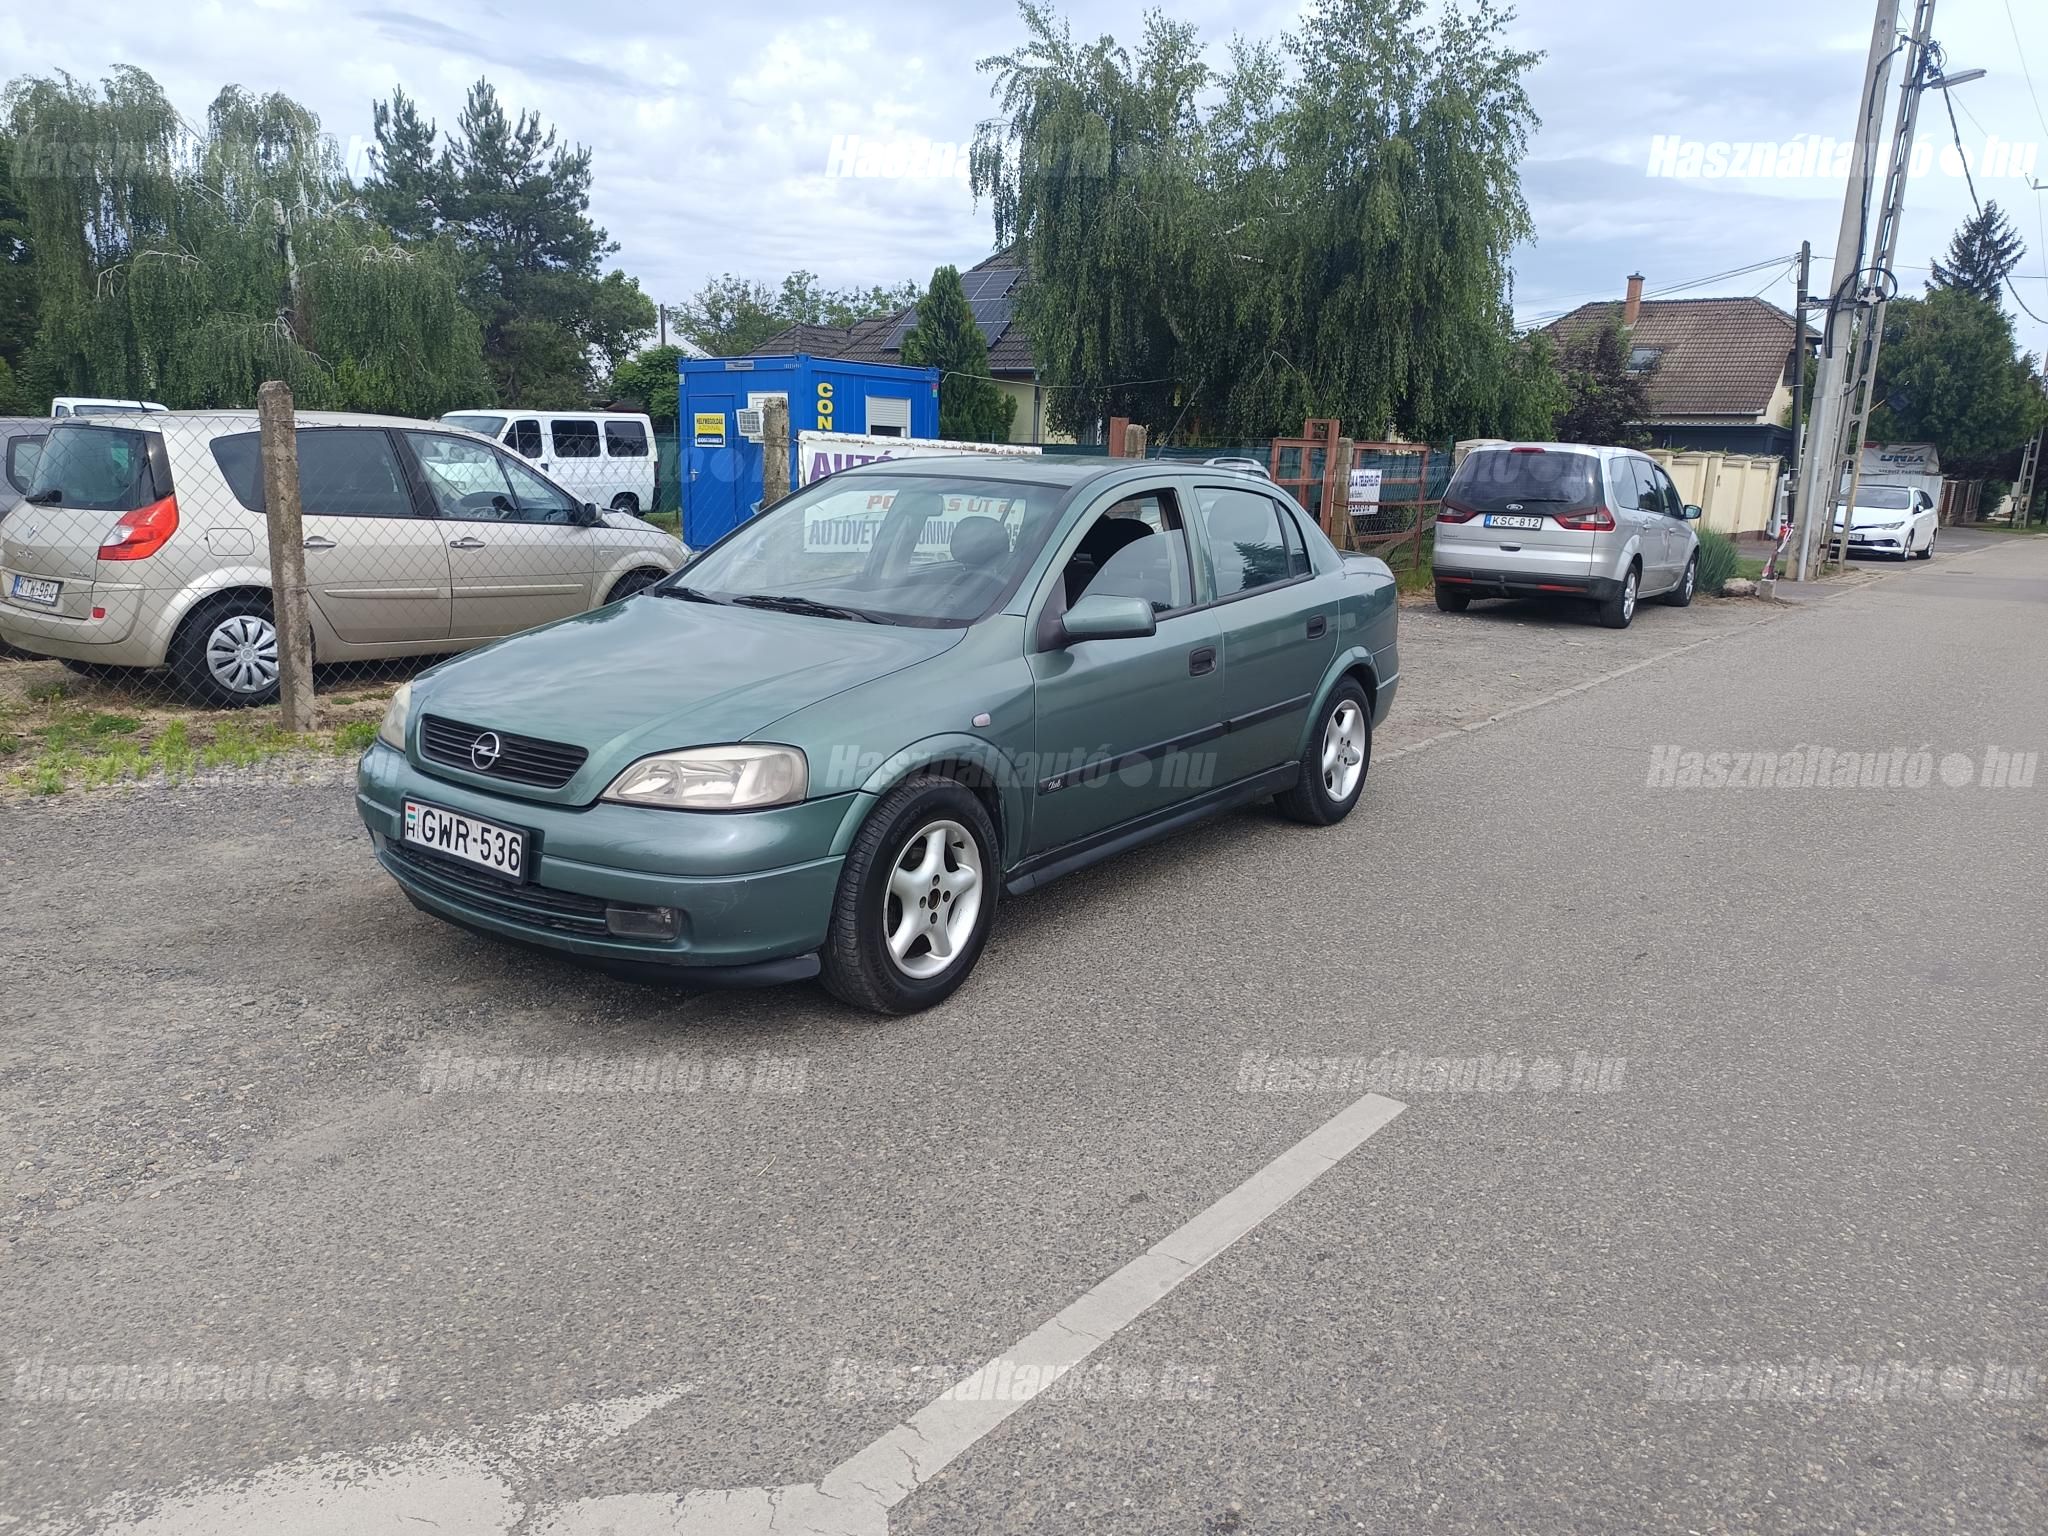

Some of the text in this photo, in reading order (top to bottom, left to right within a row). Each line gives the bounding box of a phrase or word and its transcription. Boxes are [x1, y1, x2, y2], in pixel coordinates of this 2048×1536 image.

[1492, 516, 1540, 528] KSC-812
[19, 577, 56, 599] KTW-964
[422, 809, 520, 872] GWR-536
